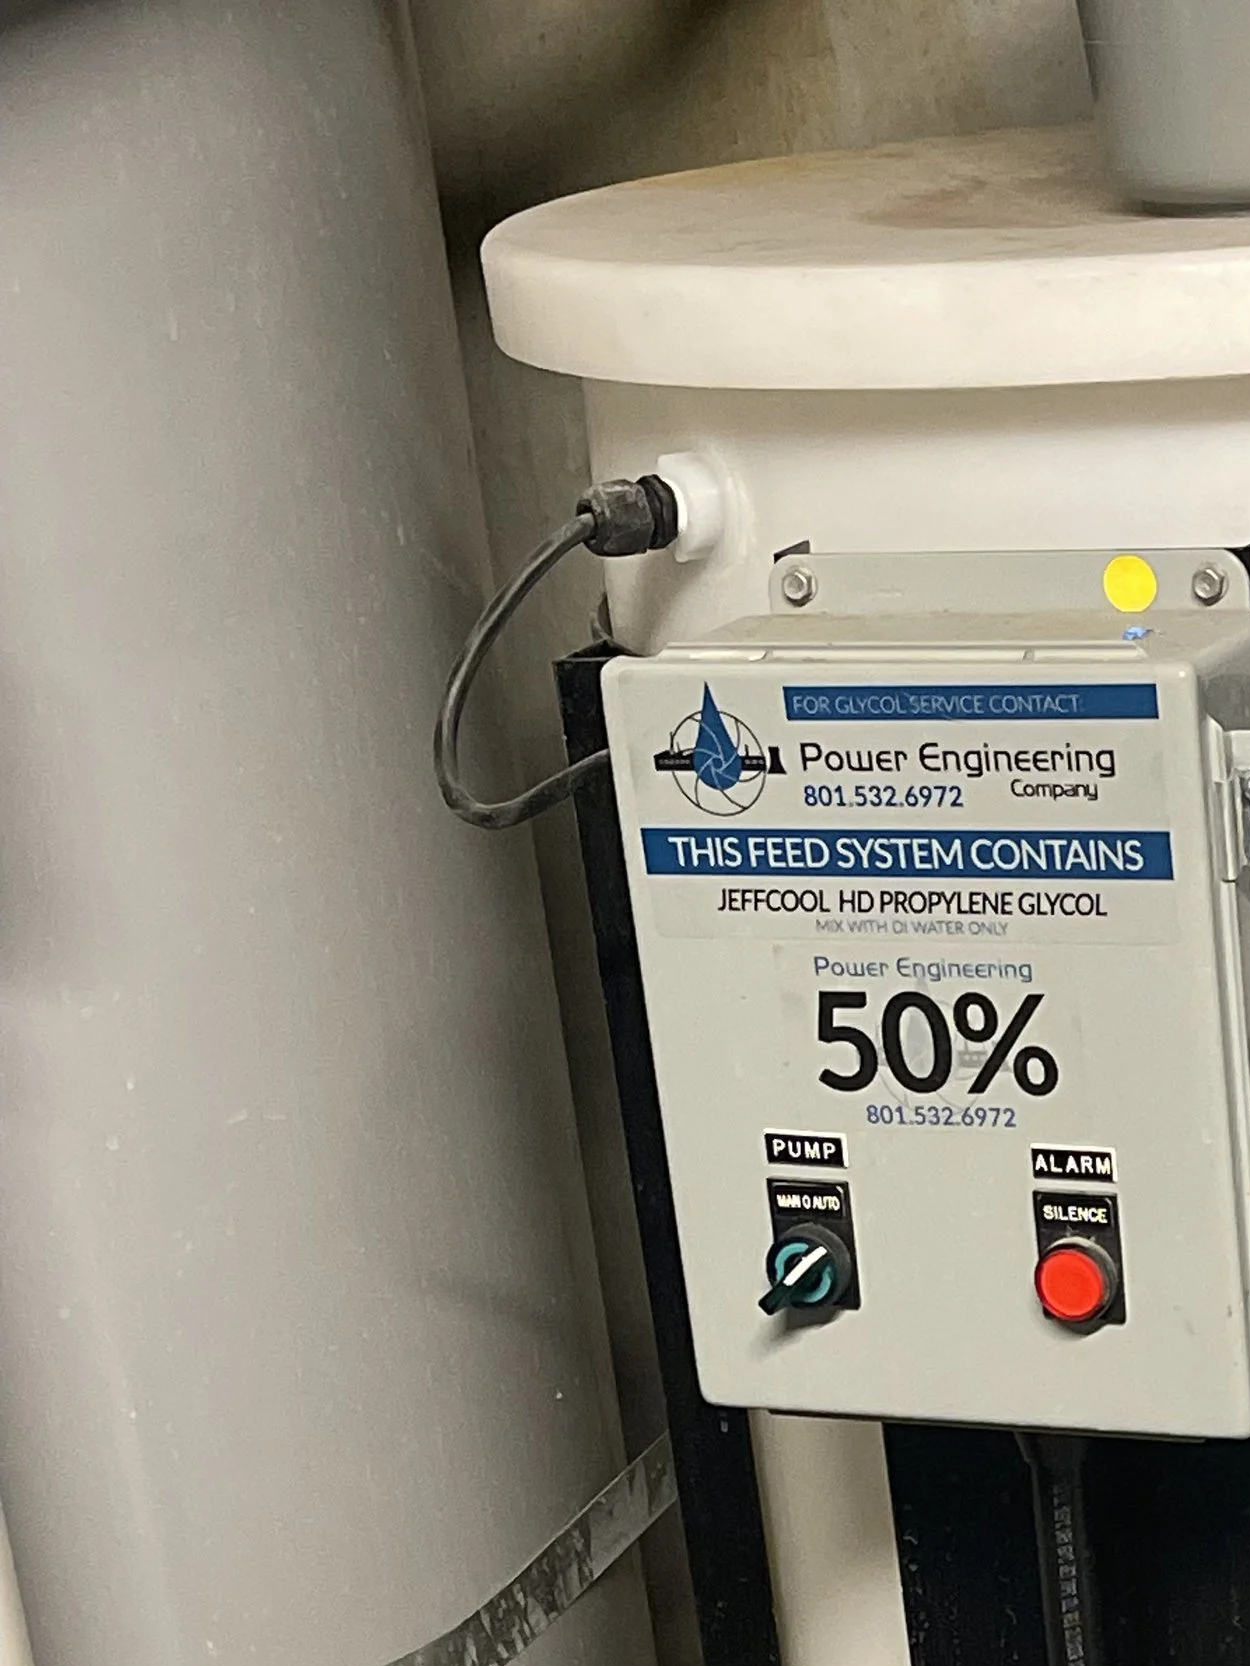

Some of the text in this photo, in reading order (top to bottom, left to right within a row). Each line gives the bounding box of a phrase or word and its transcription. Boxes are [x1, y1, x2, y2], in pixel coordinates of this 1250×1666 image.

[793, 694, 1079, 714] FOR GLYCOL SERVICE CONTACT
[800, 743, 1116, 777] Power Engineering
[804, 785, 964, 808] 801.532.6972
[1011, 779, 1098, 801] Company
[668, 836, 1144, 872] THIS FEED SYSTEM CONTAINS
[717, 888, 1108, 917] JEFFCOOL HD PROPYLENE GLYCOL
[815, 919, 844, 933] MIX
[849, 920, 888, 933] WITH
[912, 921, 964, 934] WATER
[968, 921, 1009, 936] ONLY
[813, 956, 1033, 983] Power Engineering
[818, 991, 1059, 1097] 50%
[866, 1104, 1017, 1128] 801.532.6972
[772, 1139, 836, 1160] PUMP
[1035, 1153, 1111, 1175] ALARM
[812, 1195, 841, 1211] AUTO
[1042, 1204, 1108, 1223] SILENCE
